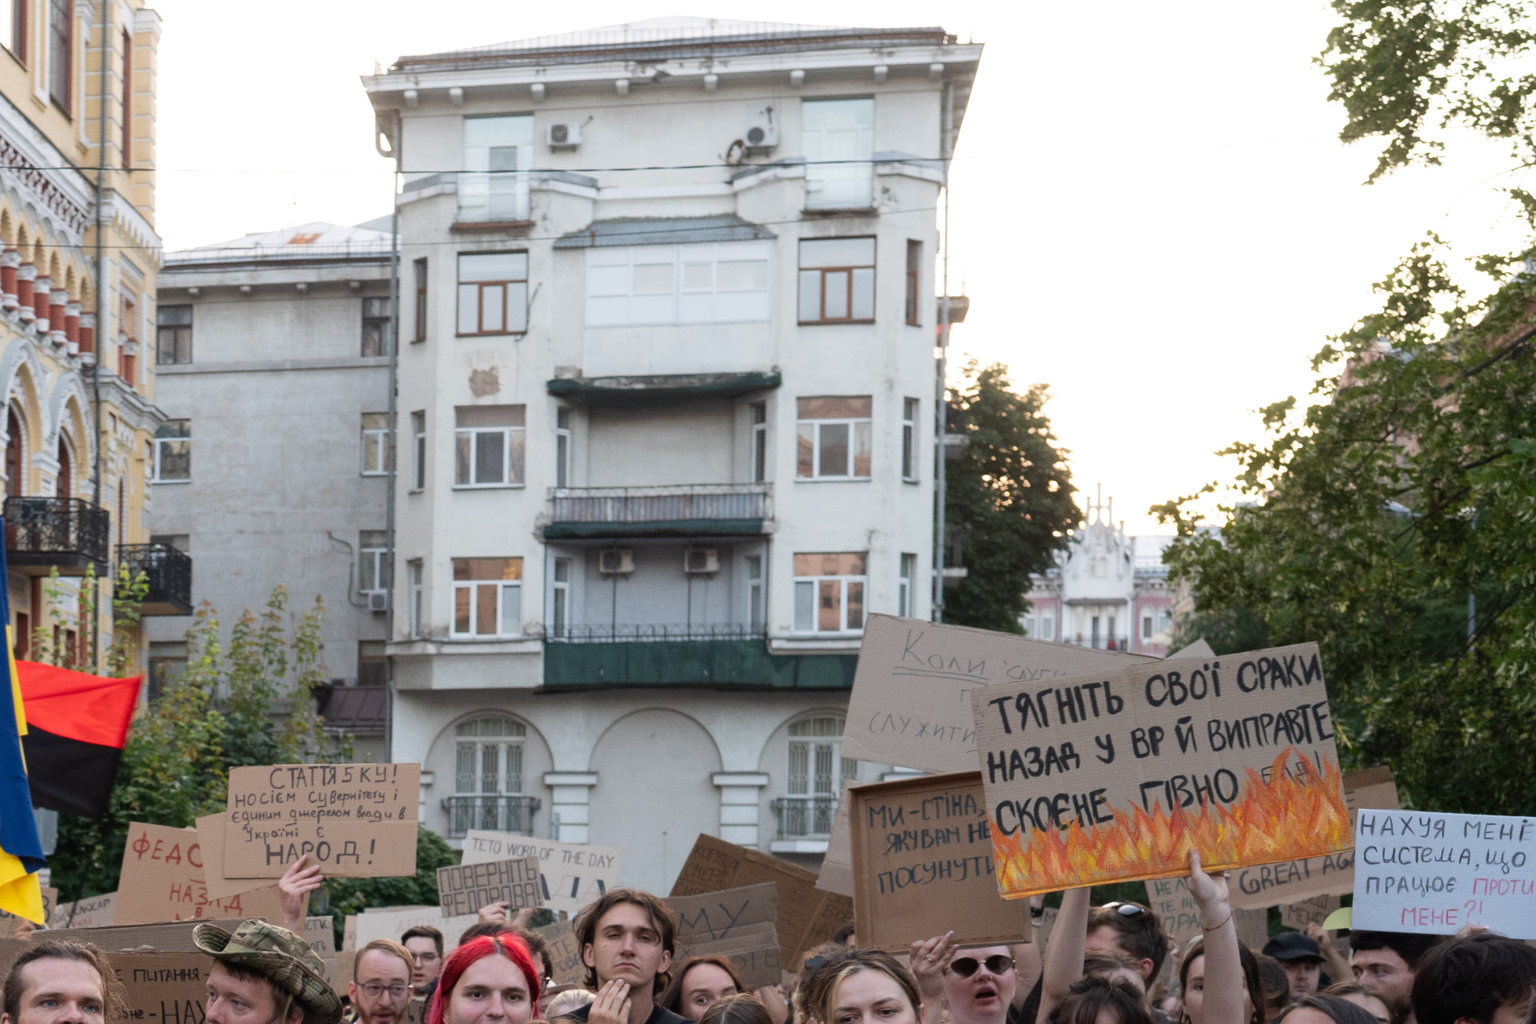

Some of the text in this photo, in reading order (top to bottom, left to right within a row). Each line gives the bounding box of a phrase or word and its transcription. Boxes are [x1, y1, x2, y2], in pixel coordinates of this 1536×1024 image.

[989, 653, 1322, 734] ТЯГНІТЬ СВОЇ СРАКИ
[987, 701, 1334, 783] НАЗАД У ВР Й ВИПРАВТЕ
[269, 765, 337, 789] СТАТТЯ
[341, 767, 354, 783] 5
[995, 787, 1114, 836] СКОЄНЕ
[1139, 767, 1238, 814] ГІВНО
[1360, 813, 1446, 839] НАХУЯ
[439, 858, 538, 893] ПОВЕРНІТЬ
[562, 850, 584, 865] THE
[588, 854, 616, 869] DAY
[1238, 859, 1312, 895] GREAT
